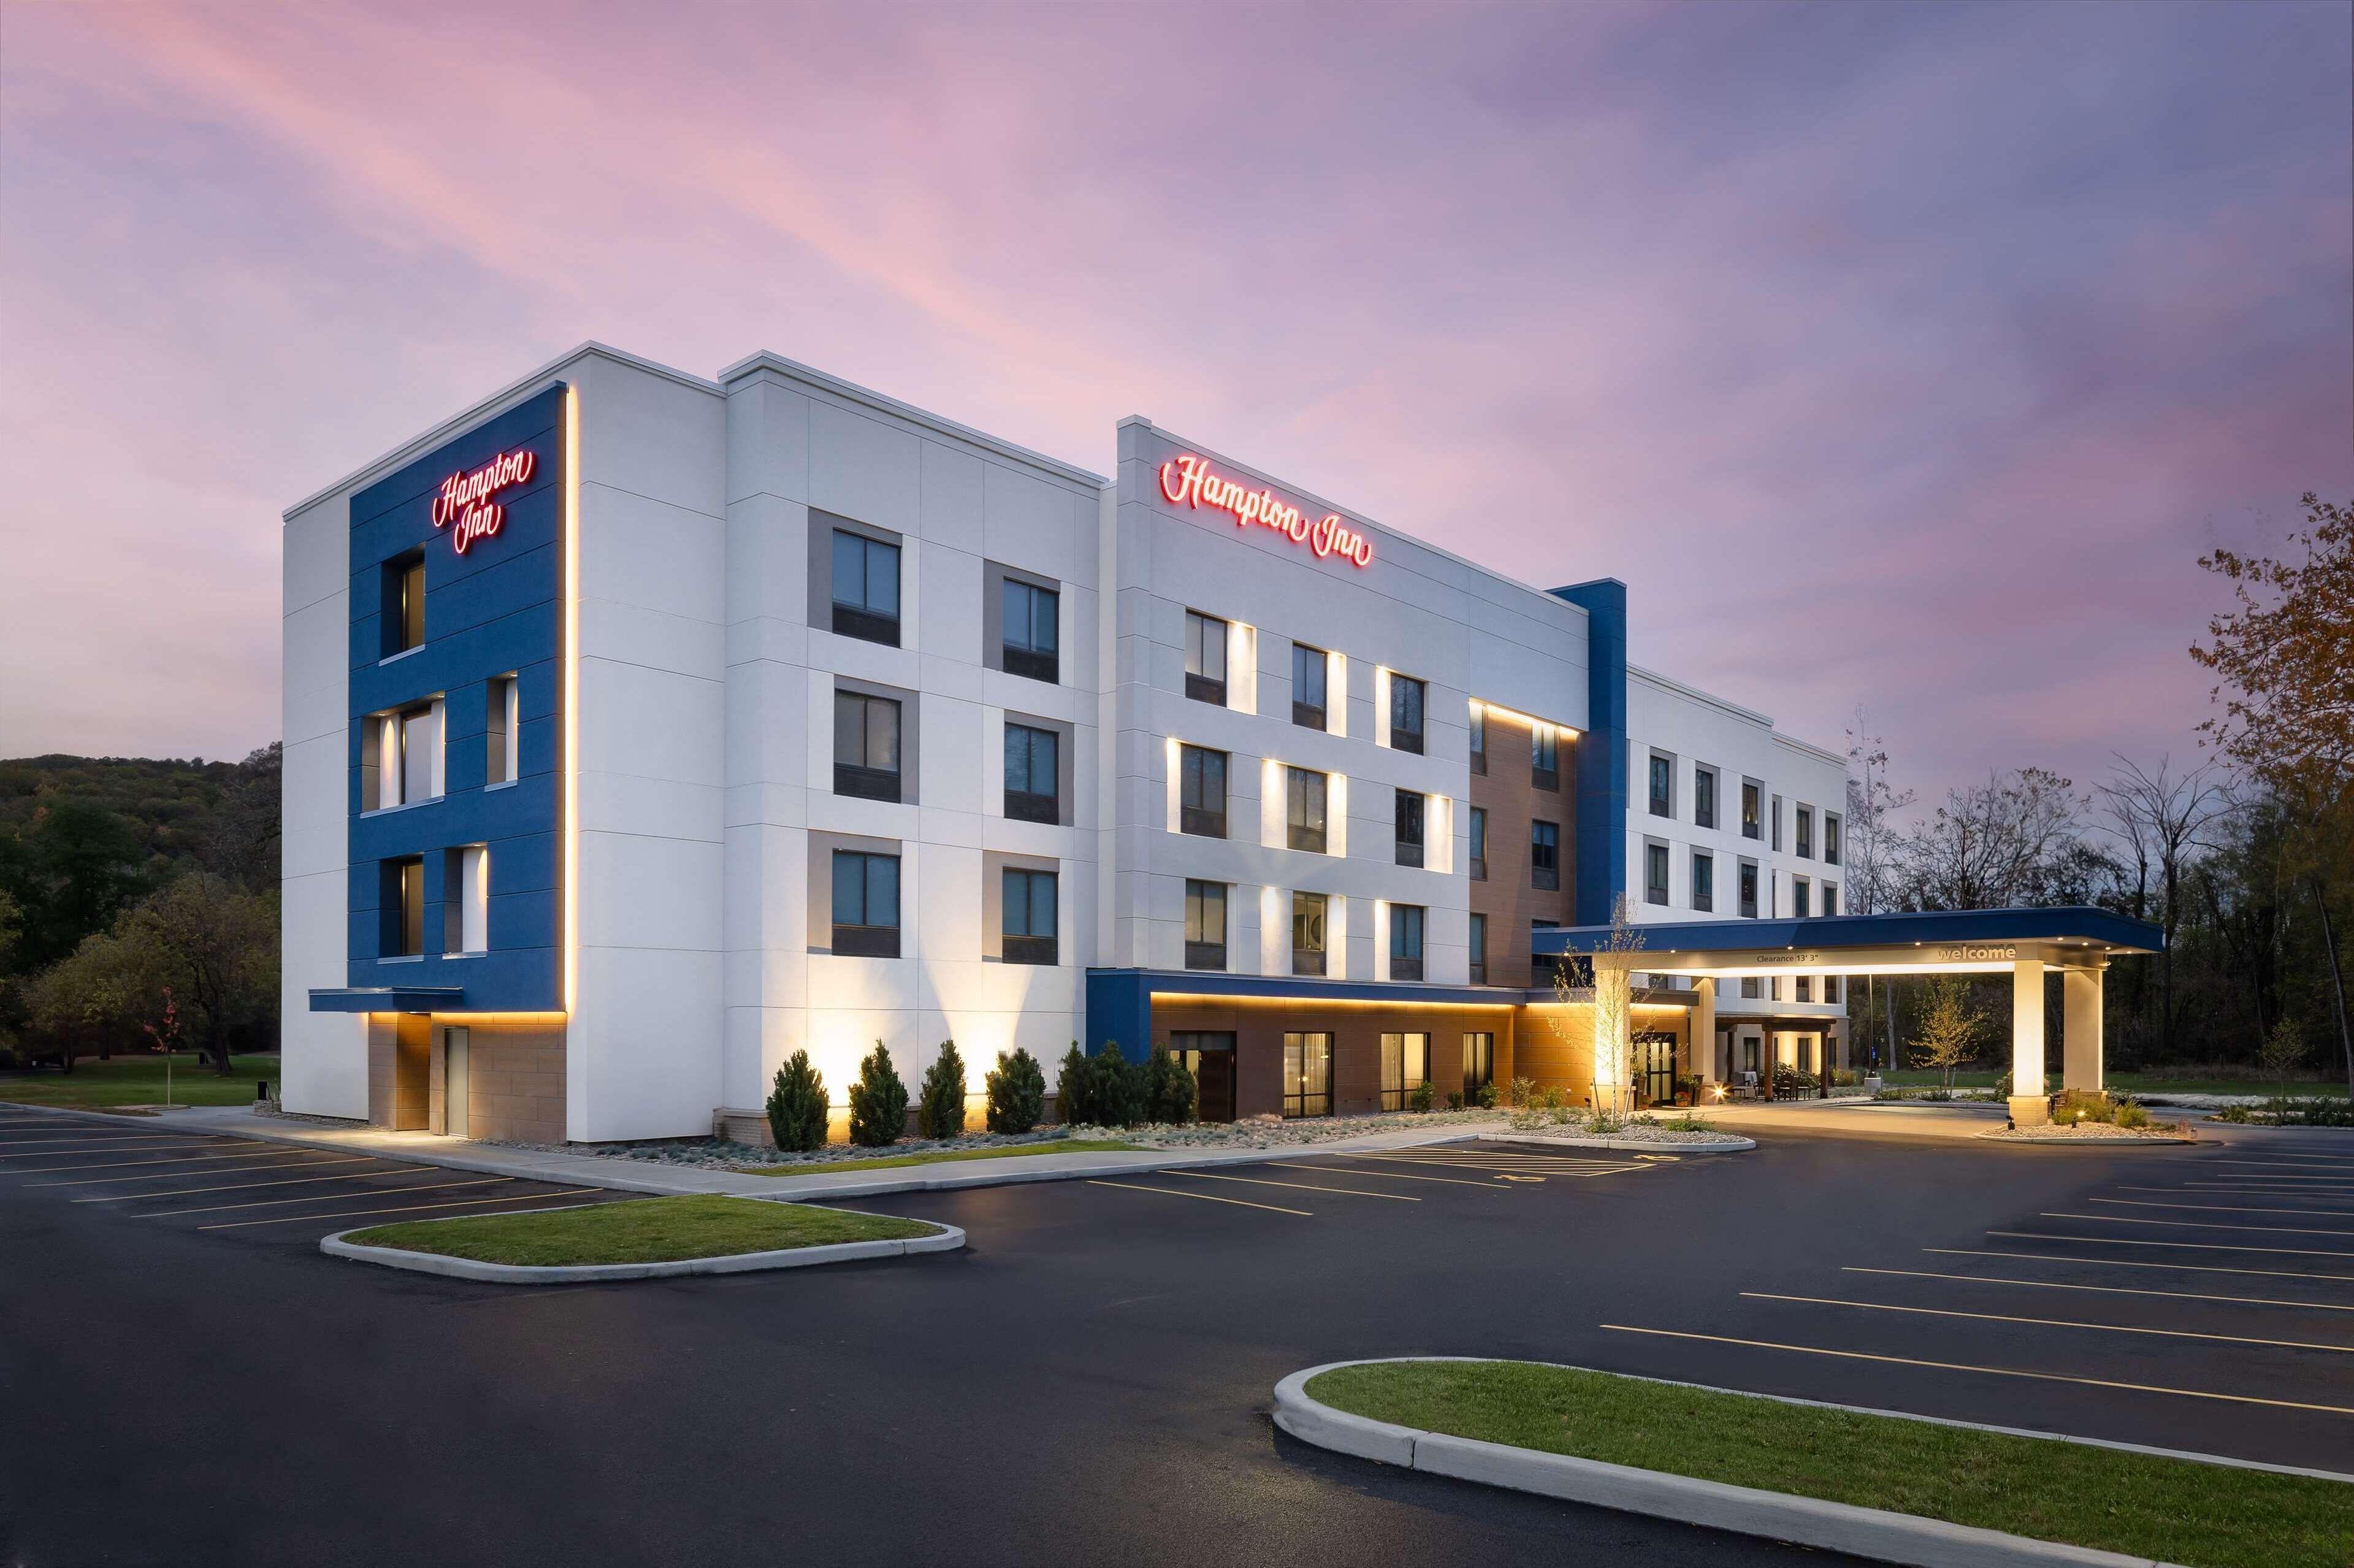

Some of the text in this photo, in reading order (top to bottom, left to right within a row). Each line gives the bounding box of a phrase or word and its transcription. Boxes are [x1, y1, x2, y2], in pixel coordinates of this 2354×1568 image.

[433, 451, 532, 527] Hampton
[1160, 456, 1372, 567] Hampton Inn
[454, 502, 501, 554] Inn
[1938, 946, 2016, 960] welcome
